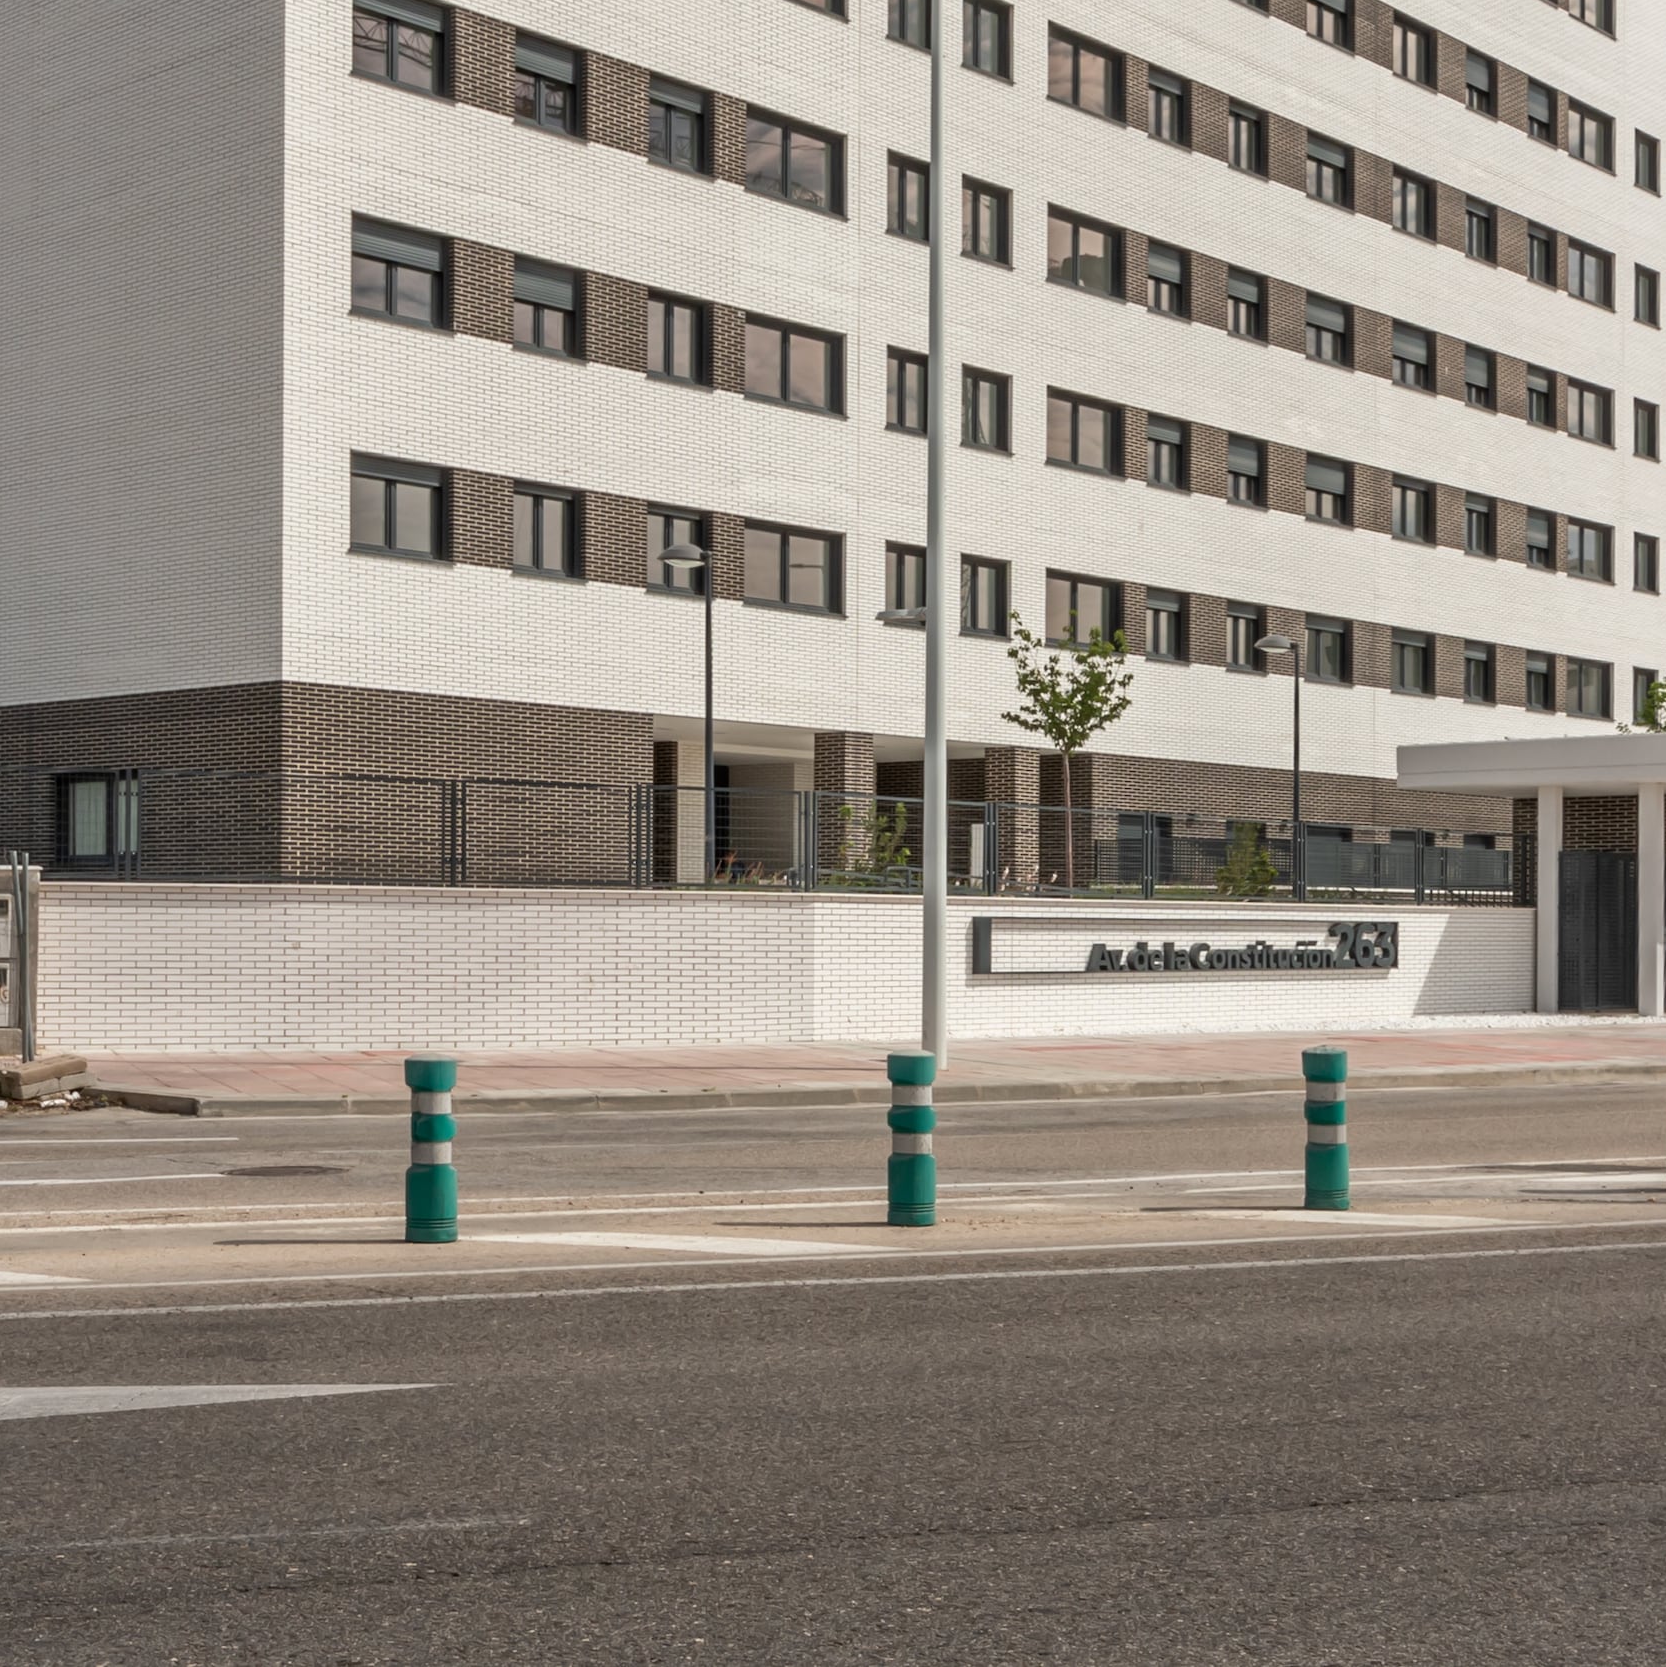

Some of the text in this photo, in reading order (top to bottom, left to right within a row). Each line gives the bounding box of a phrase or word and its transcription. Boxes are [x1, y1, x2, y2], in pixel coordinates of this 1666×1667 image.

[1085, 922, 1399, 971] Av. de la Constitución 263
